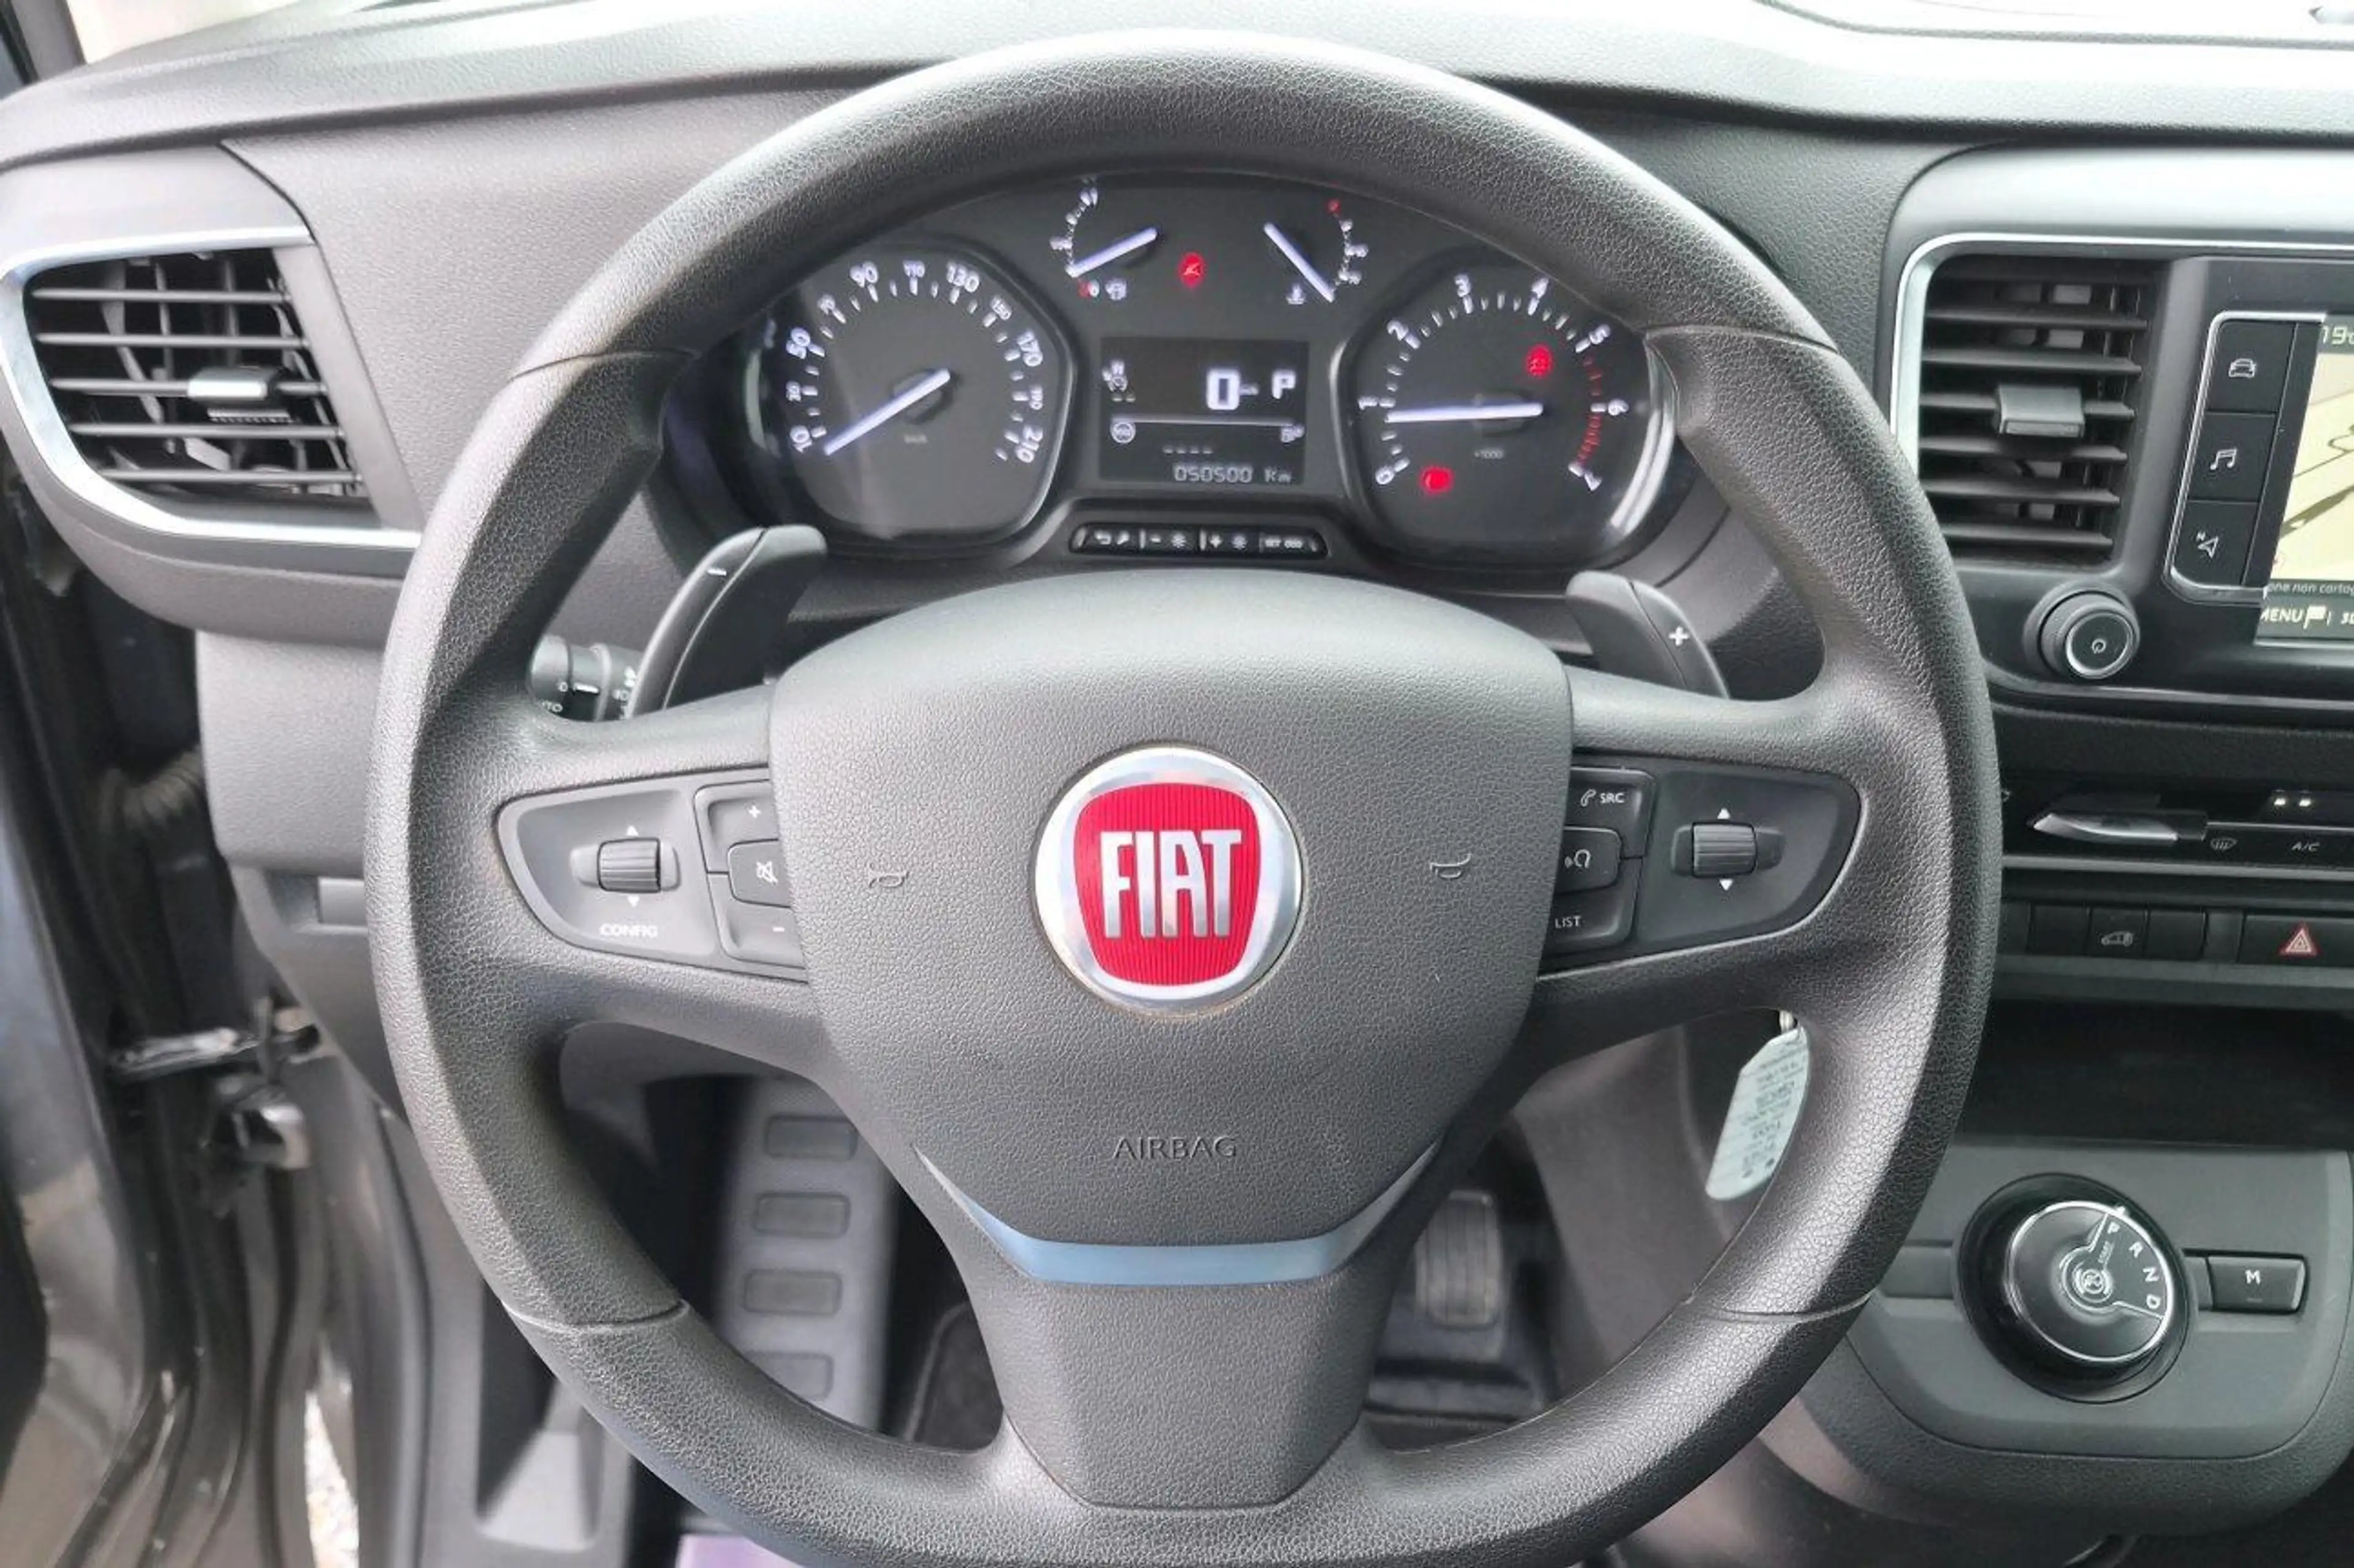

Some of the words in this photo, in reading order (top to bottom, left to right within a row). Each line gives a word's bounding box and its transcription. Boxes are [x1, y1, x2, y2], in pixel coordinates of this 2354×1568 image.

[850, 261, 878, 288] 90
[1455, 274, 1471, 297] 3
[1387, 320, 1409, 341] 2
[1588, 324, 1611, 344] 5
[785, 327, 810, 359] 50
[1271, 368, 1297, 399] P
[1374, 465, 1395, 485] 0
[1599, 792, 1625, 804] SRC
[2291, 841, 2320, 853] A/C
[1100, 829, 1242, 939] FIAT
[598, 923, 658, 939] CONFIG
[1555, 915, 1582, 929] LIST
[1113, 1135, 1238, 1160] AIRBAG
[2107, 1222, 2120, 1235] P
[2128, 1241, 2143, 1258] R
[2143, 1267, 2160, 1282] N
[2245, 1269, 2260, 1285] M
[2146, 1293, 2161, 1309] D
